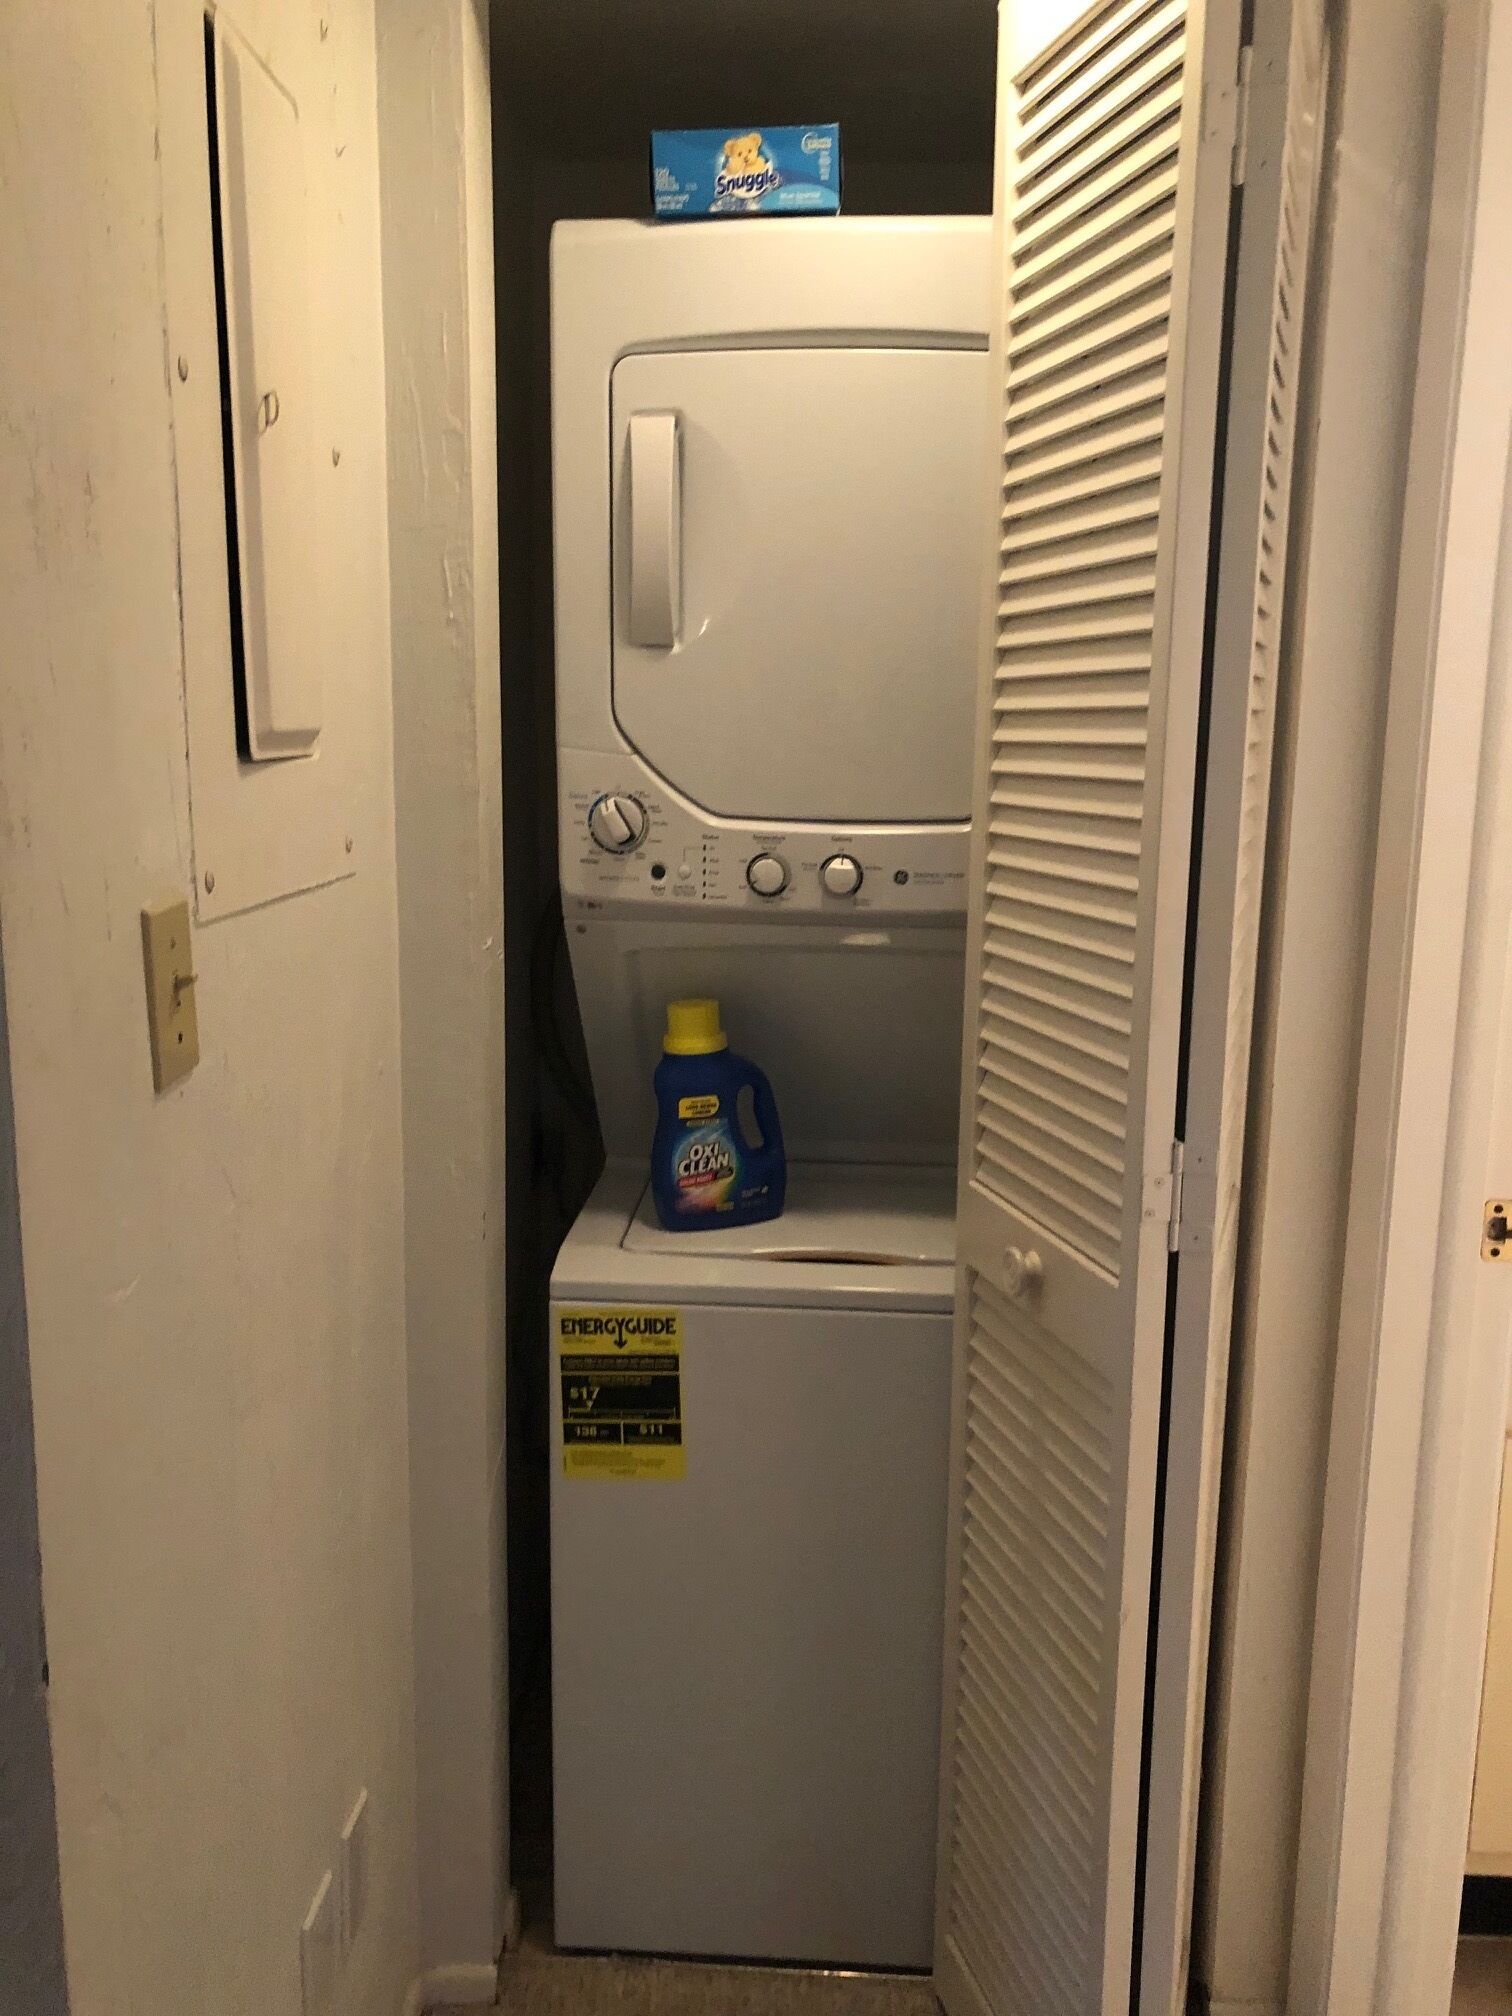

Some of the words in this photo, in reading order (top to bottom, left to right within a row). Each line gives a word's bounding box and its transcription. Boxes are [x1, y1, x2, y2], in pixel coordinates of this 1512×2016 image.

[716, 171, 777, 194] Snuggle
[690, 1143, 719, 1161] OXI
[679, 1153, 730, 1176] CLEAN
[560, 1317, 677, 1338] ENERGYGUIDE
